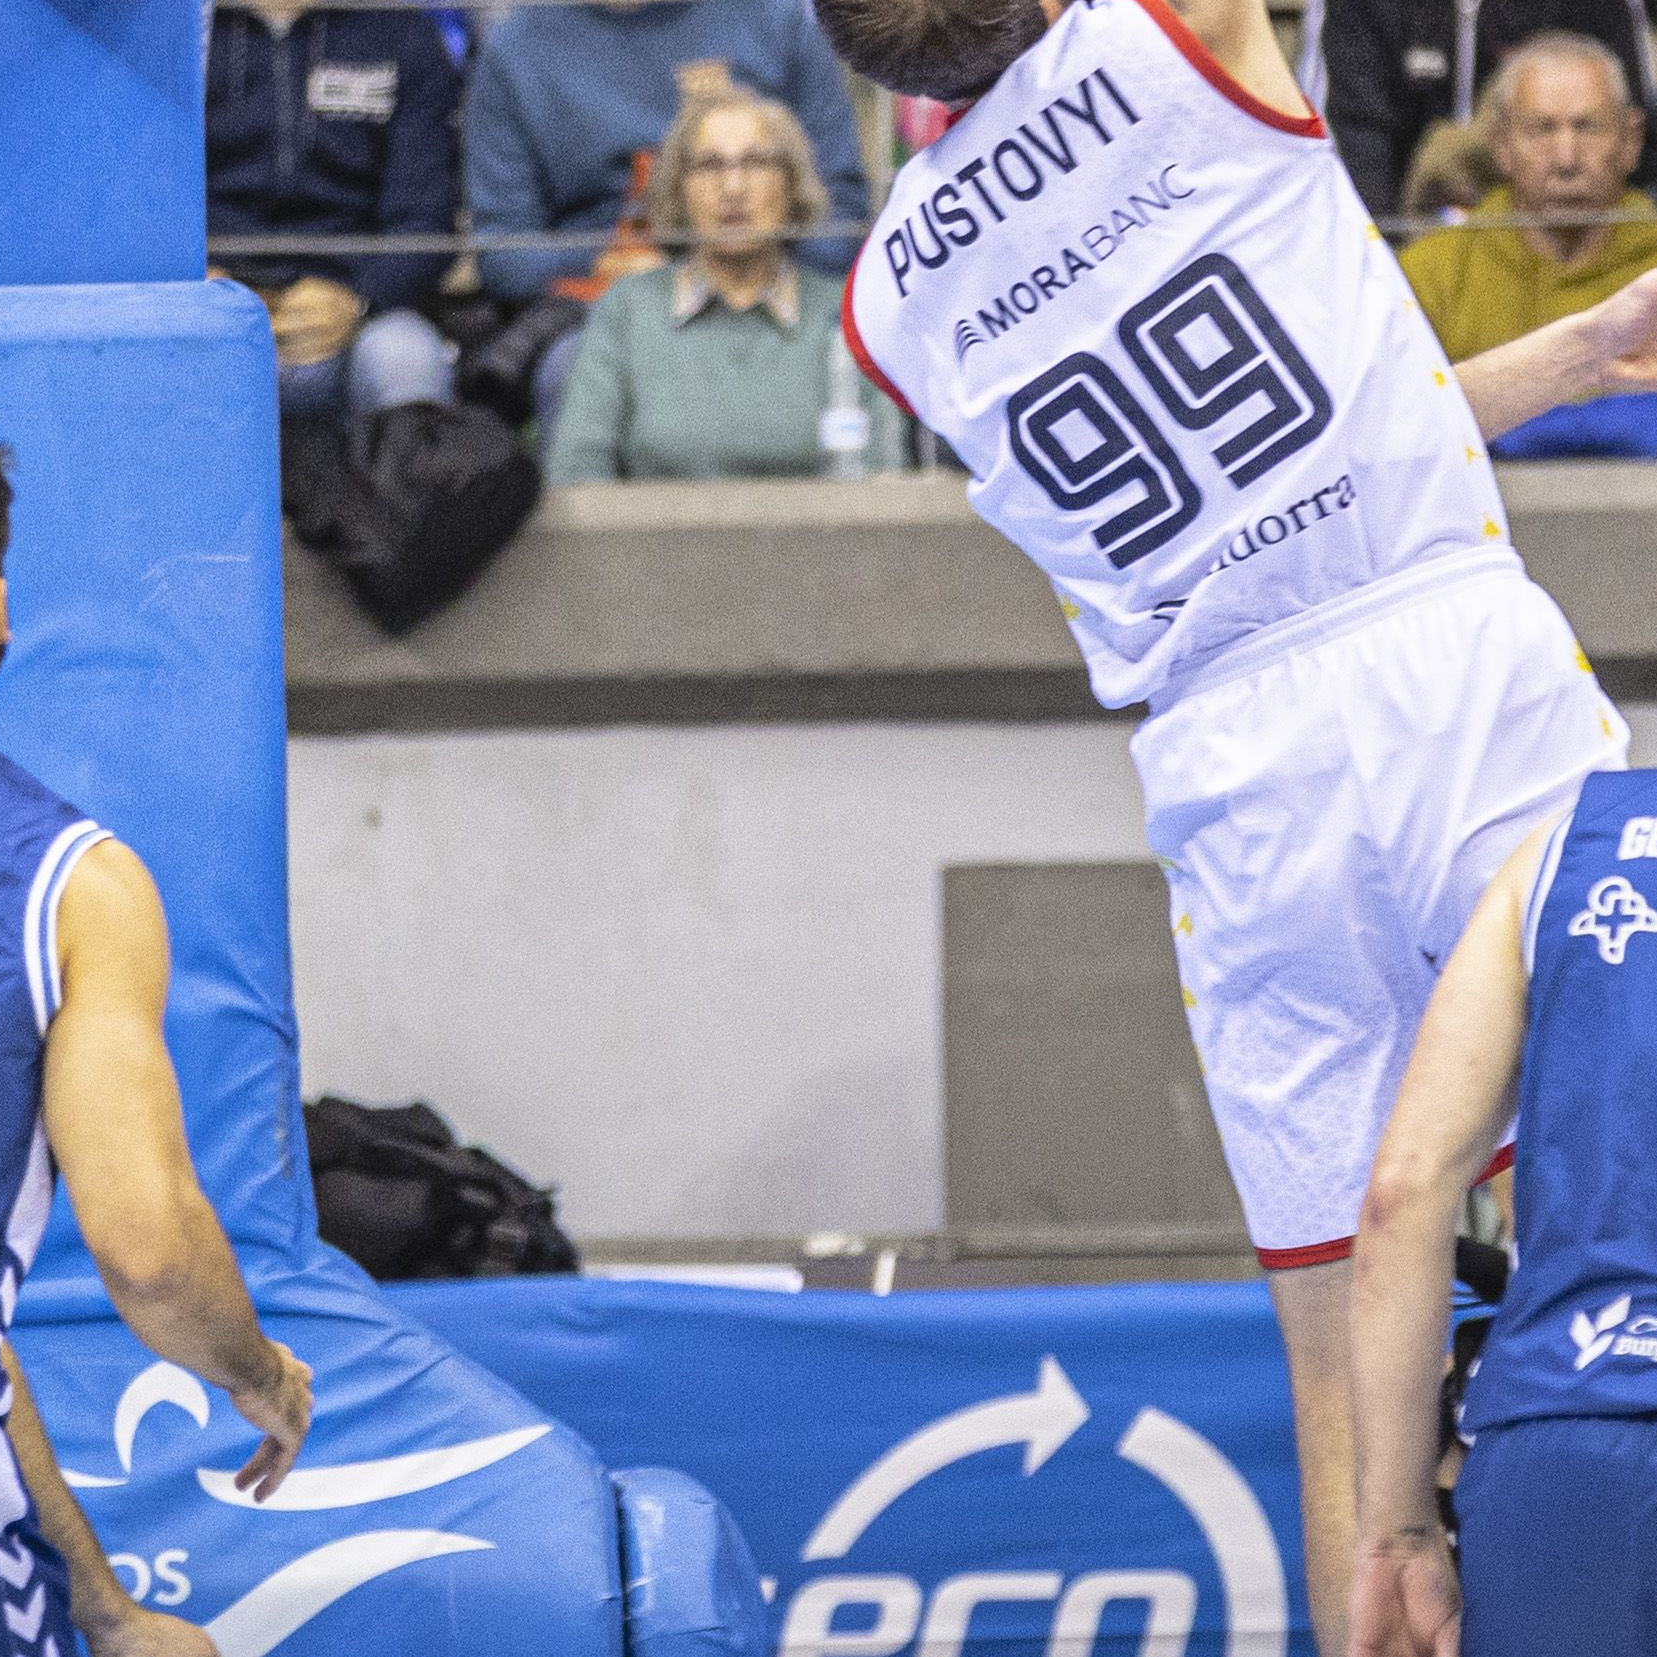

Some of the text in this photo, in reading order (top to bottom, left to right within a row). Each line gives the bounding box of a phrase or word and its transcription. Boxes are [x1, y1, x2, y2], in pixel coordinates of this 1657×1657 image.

[884, 67, 1143, 297] PUSTOVYI
[982, 164, 1197, 341] MORABANC
[1008, 253, 1332, 571] 99
